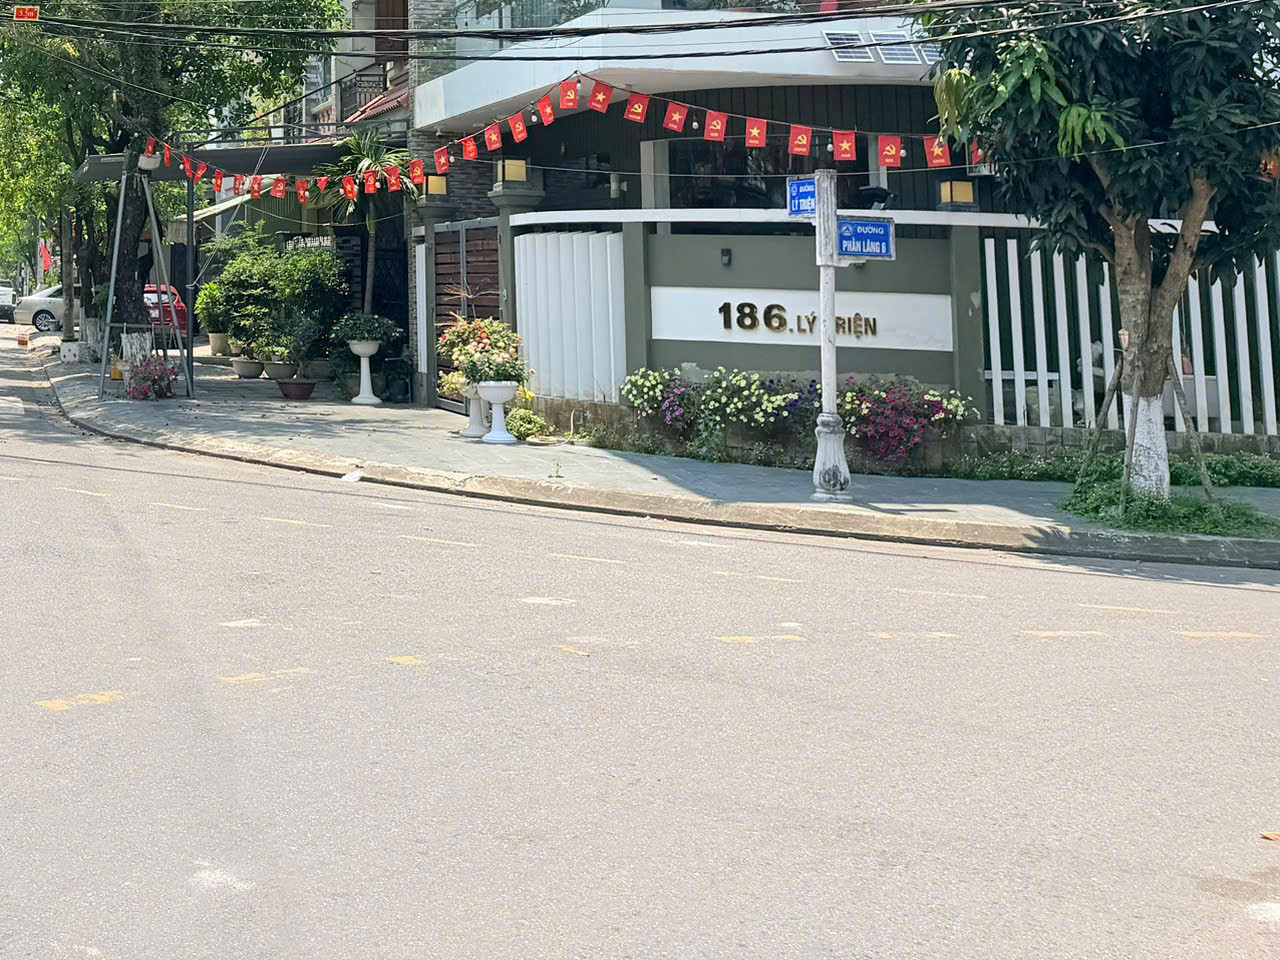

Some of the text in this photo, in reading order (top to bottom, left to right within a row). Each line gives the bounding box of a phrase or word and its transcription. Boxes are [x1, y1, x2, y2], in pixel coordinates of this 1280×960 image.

[791, 196, 799, 212] LÝ
[856, 224, 885, 235] ĐƯỜNG
[881, 241, 887, 254] 6
[834, 312, 878, 339] RIỆN
